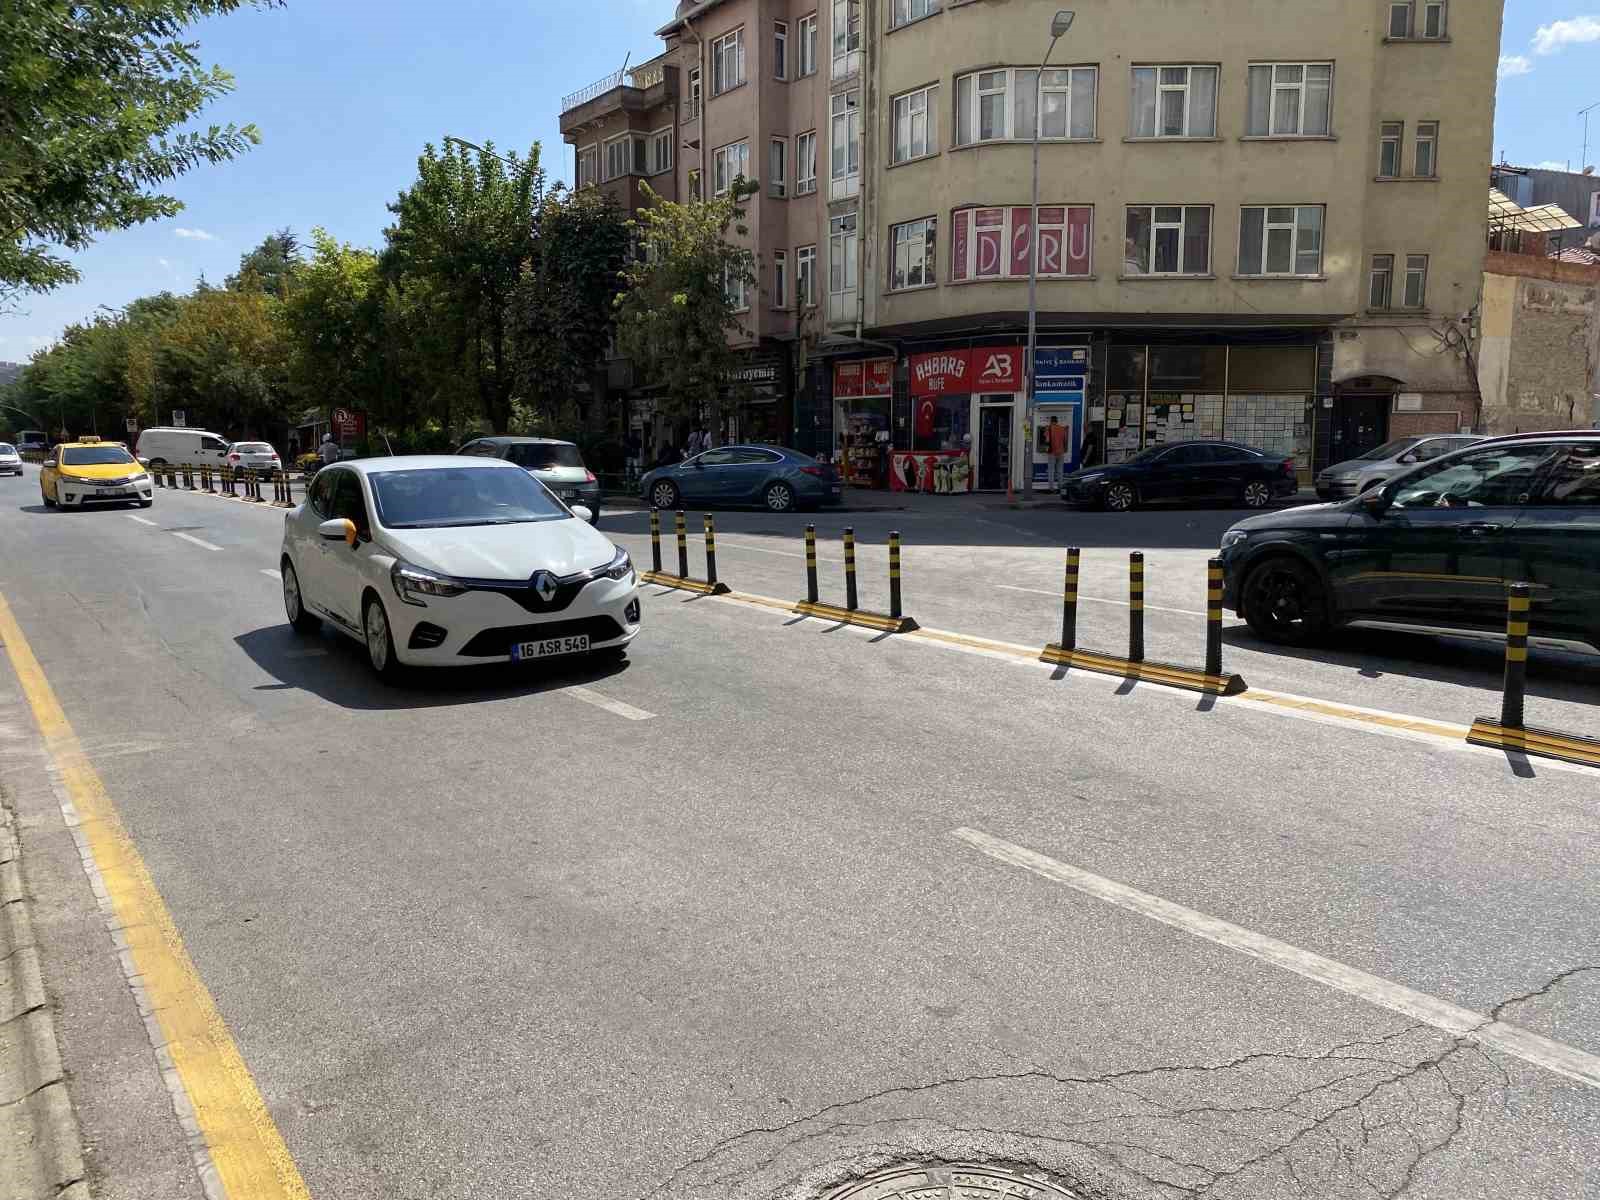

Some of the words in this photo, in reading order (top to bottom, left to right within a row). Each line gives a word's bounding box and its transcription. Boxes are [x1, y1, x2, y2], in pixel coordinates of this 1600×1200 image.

[914, 355, 967, 383] AYBARS
[521, 644, 534, 657] 16
[538, 640, 561, 655] ASR
[564, 637, 587, 652] 549
